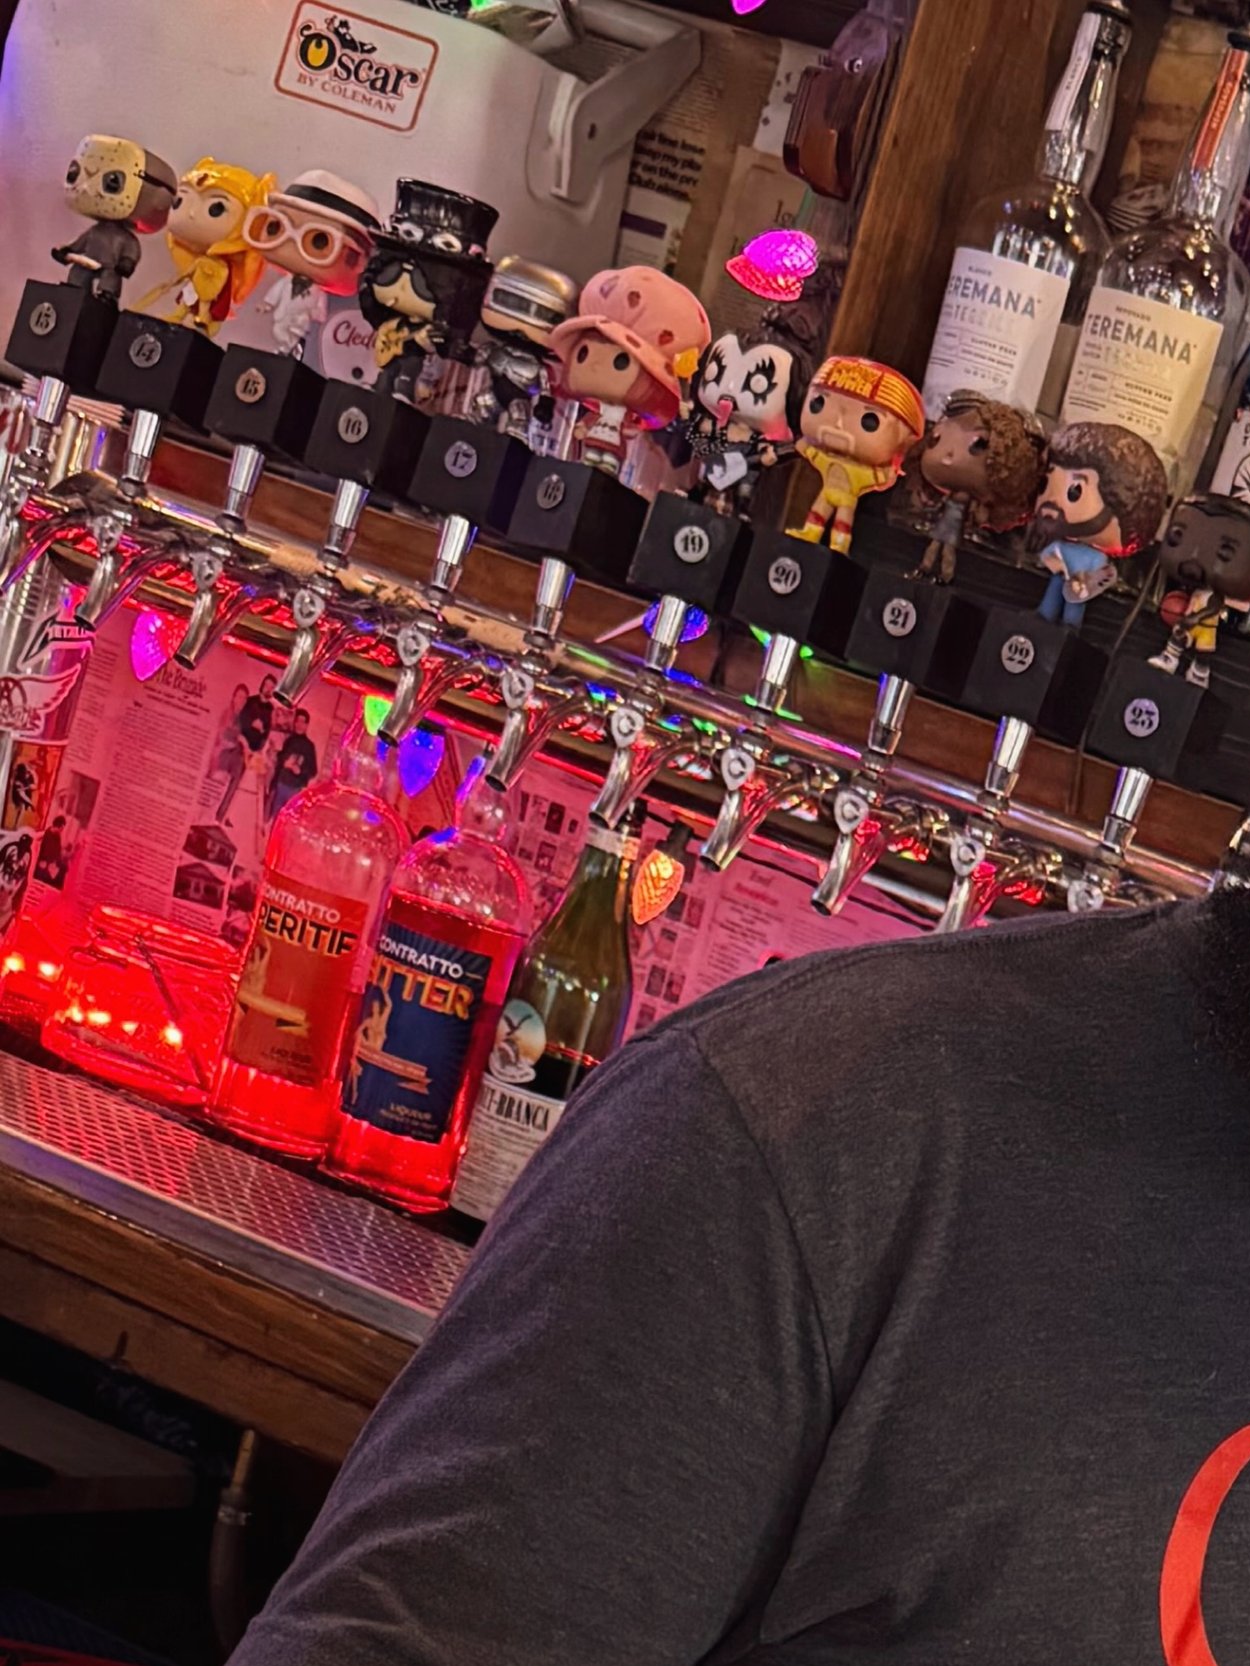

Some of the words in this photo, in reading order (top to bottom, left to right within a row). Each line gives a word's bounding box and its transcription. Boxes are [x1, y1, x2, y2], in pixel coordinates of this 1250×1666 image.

[300, 24, 419, 97] Oscar
[297, 73, 317, 88] BY
[321, 81, 396, 114] COLEMAN
[450, 448, 473, 470] 17
[681, 532, 704, 554] 19
[773, 565, 797, 587] 20
[889, 607, 910, 628] 21
[1007, 643, 1030, 665] 22
[369, 951, 476, 1021] ITTER
